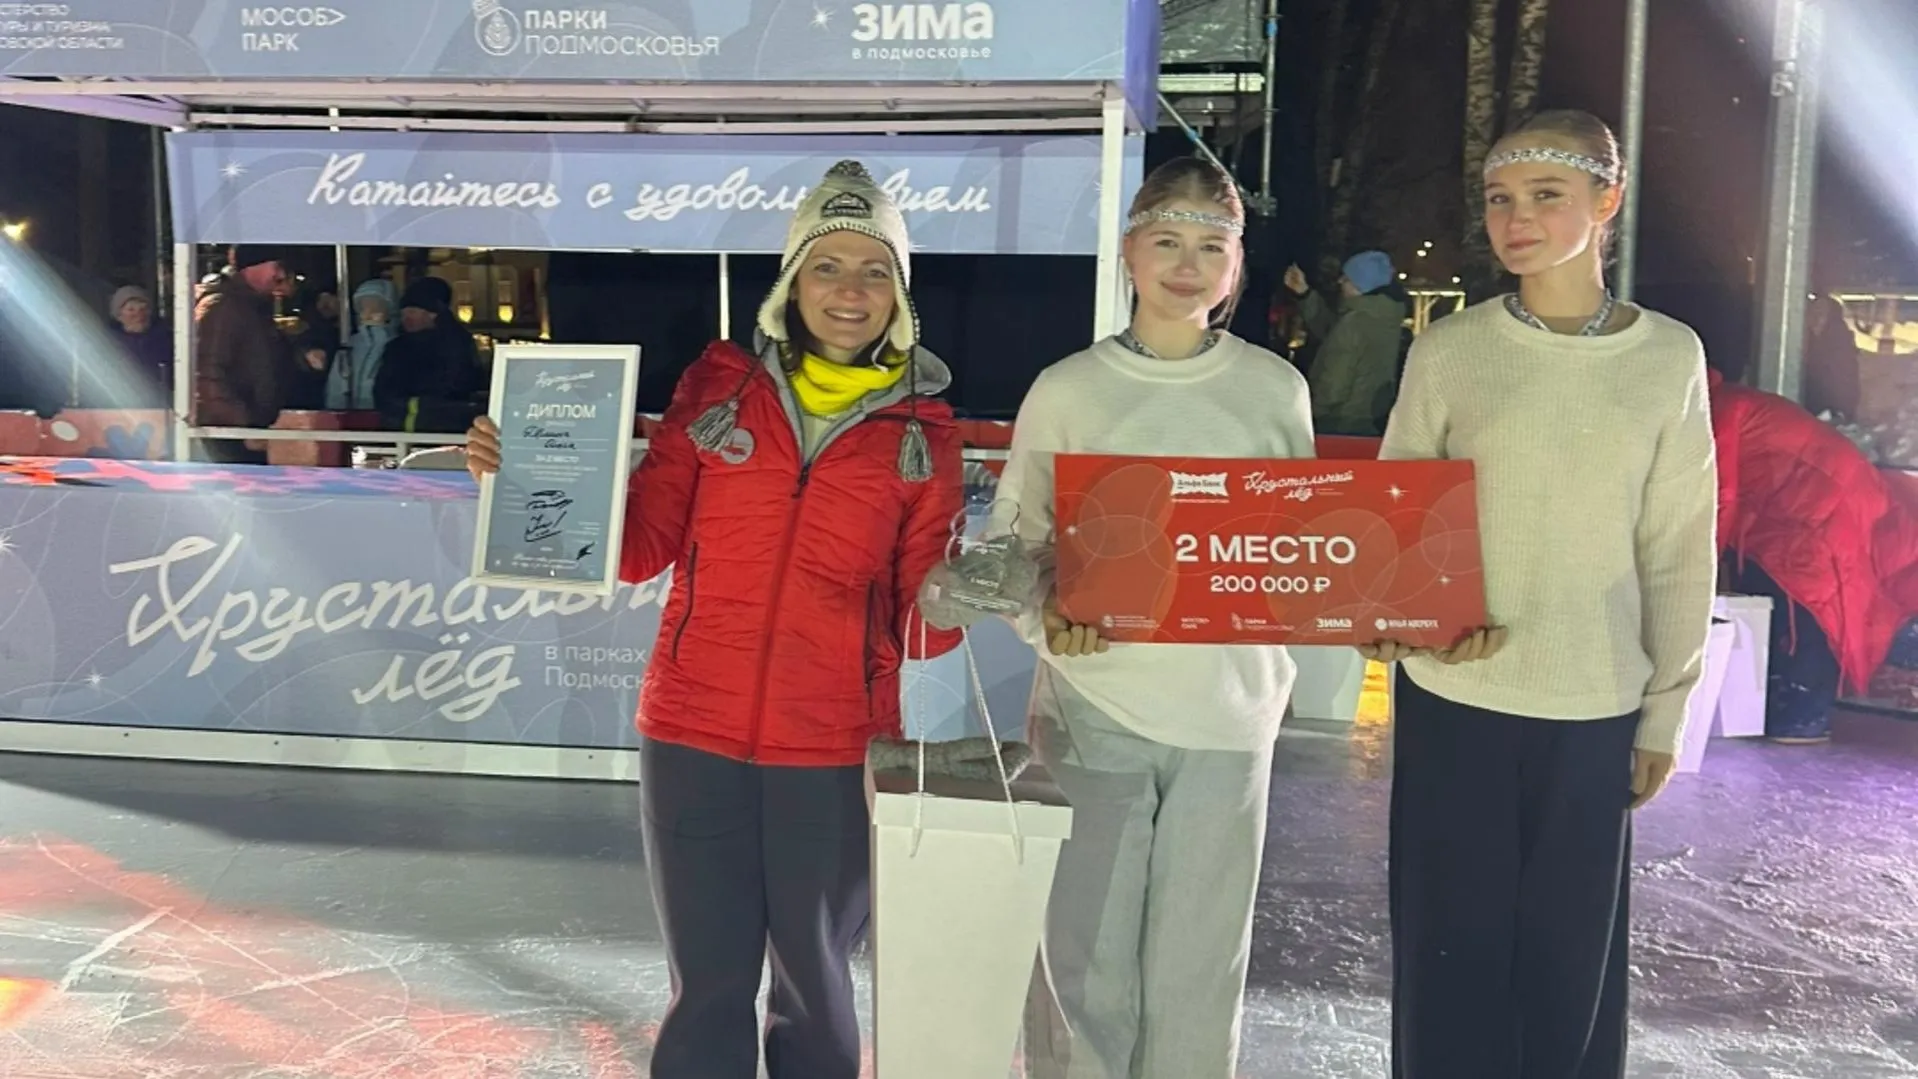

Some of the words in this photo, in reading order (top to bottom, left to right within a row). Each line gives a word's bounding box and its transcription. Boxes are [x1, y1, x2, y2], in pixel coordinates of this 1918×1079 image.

[525, 10, 607, 30] ПАРКИ
[241, 33, 300, 51] ПАРК
[525, 35, 720, 56] ПОДМОСКОВЬЯ
[867, 47, 992, 61] подмосковье
[307, 152, 561, 209] Катайтесь
[586, 183, 615, 209] с
[526, 403, 597, 420] ДИПЛОМ
[1242, 470, 1354, 495] Хрустальный
[1175, 534, 1199, 562] 2
[1209, 535, 1357, 564] МЕСТО
[1210, 575, 1256, 593] 200
[1260, 576, 1309, 593] 000
[545, 645, 557, 660] в
[565, 645, 648, 664] парках
[352, 632, 522, 722] лёд
